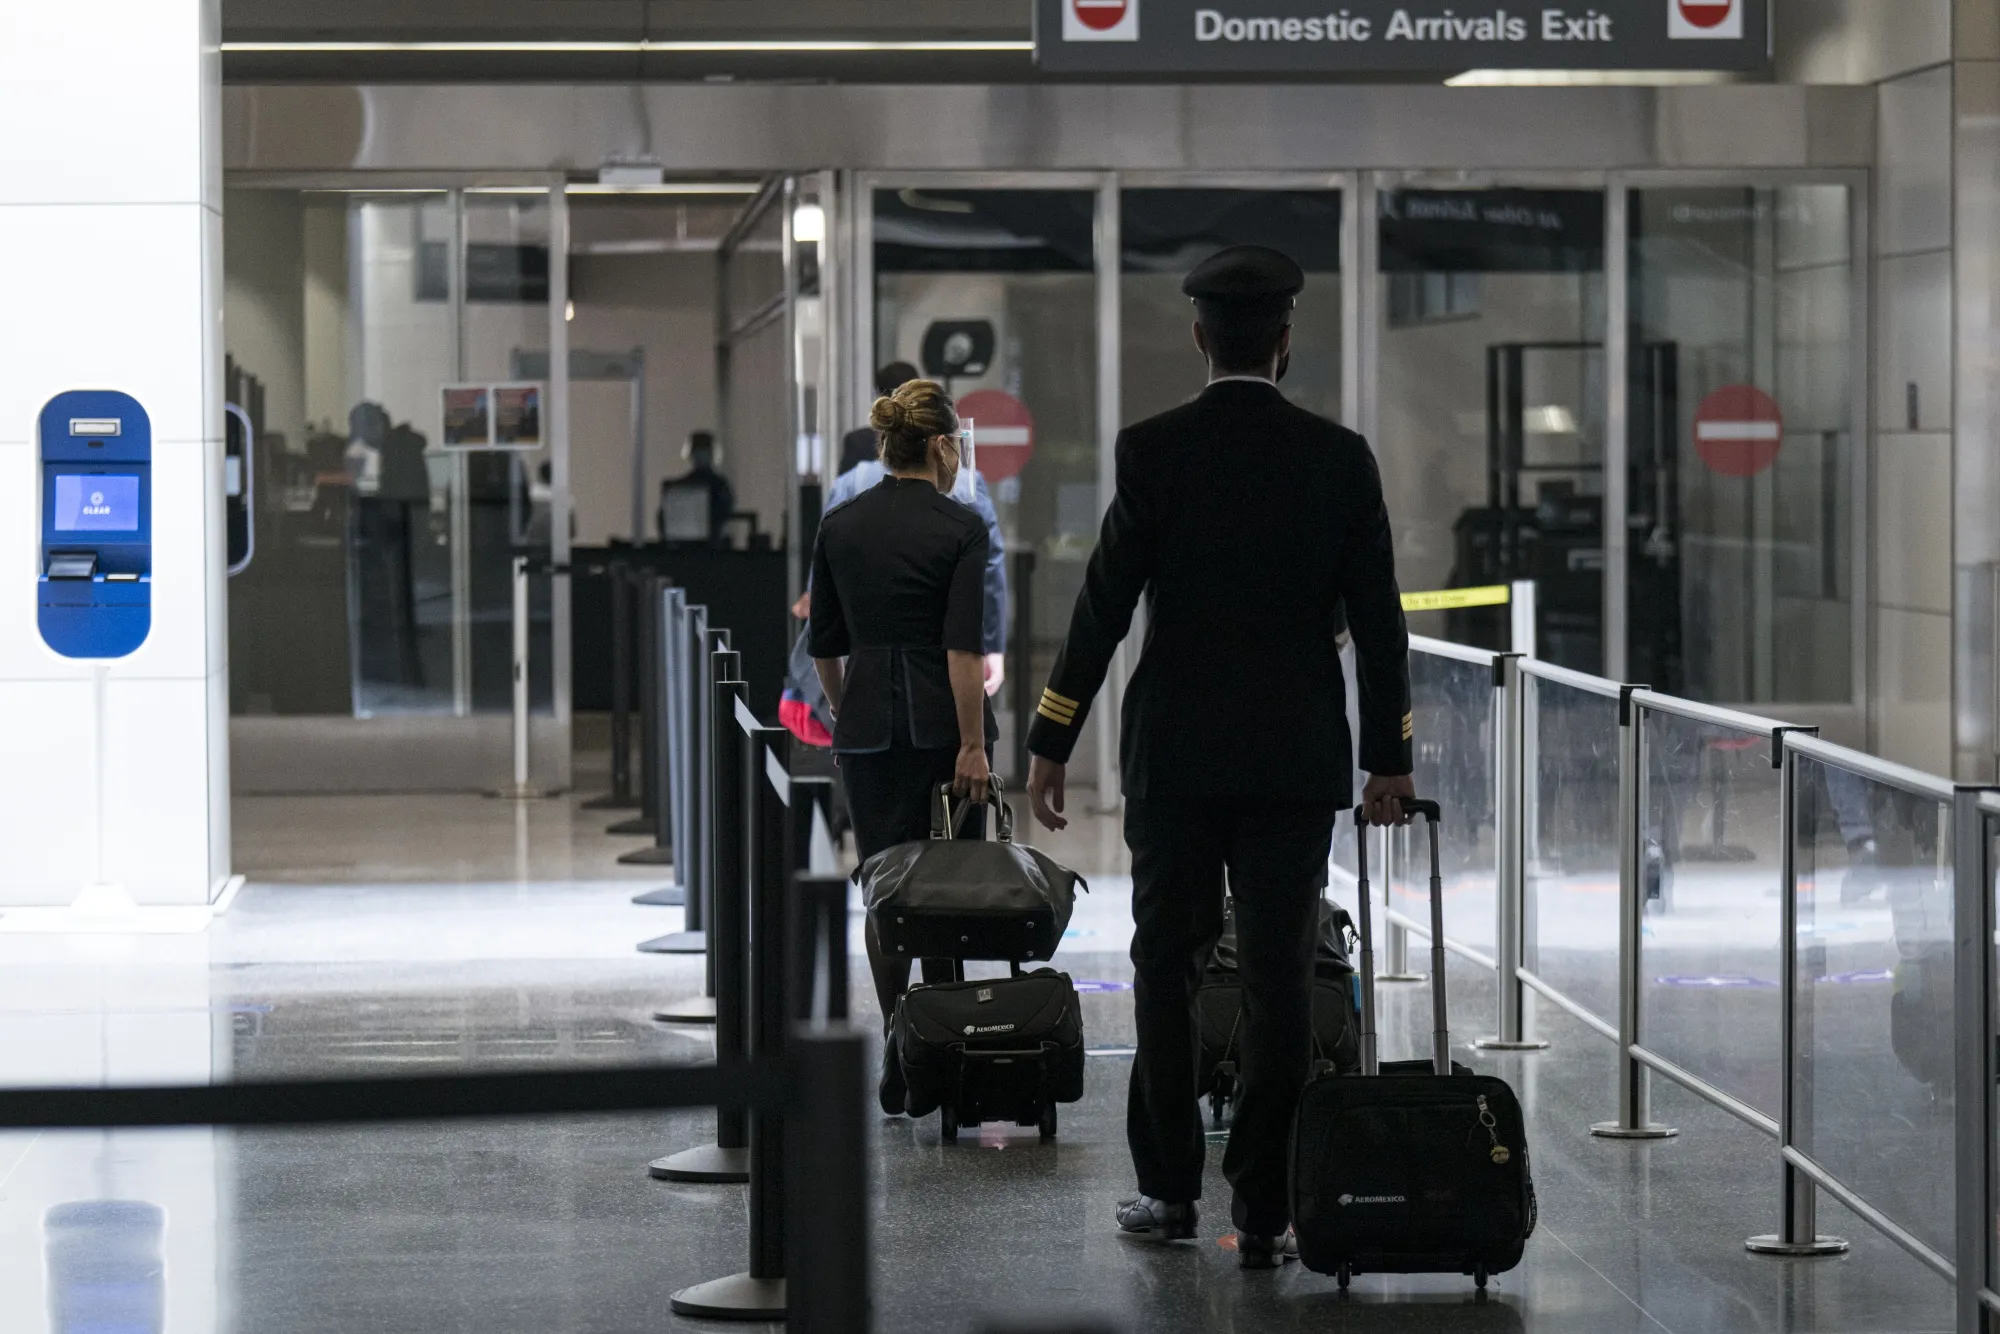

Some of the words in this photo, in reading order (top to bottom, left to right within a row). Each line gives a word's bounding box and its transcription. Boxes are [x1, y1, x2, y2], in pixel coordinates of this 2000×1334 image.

[1195, 9, 1371, 41] Domestic
[1385, 9, 1527, 41] Arrivals
[1542, 9, 1613, 41] Exit
[83, 505, 111, 514] CLEAR
[976, 1023, 1015, 1033] AEROMEXICO
[1354, 1195, 1405, 1203] AEROMEXICO
